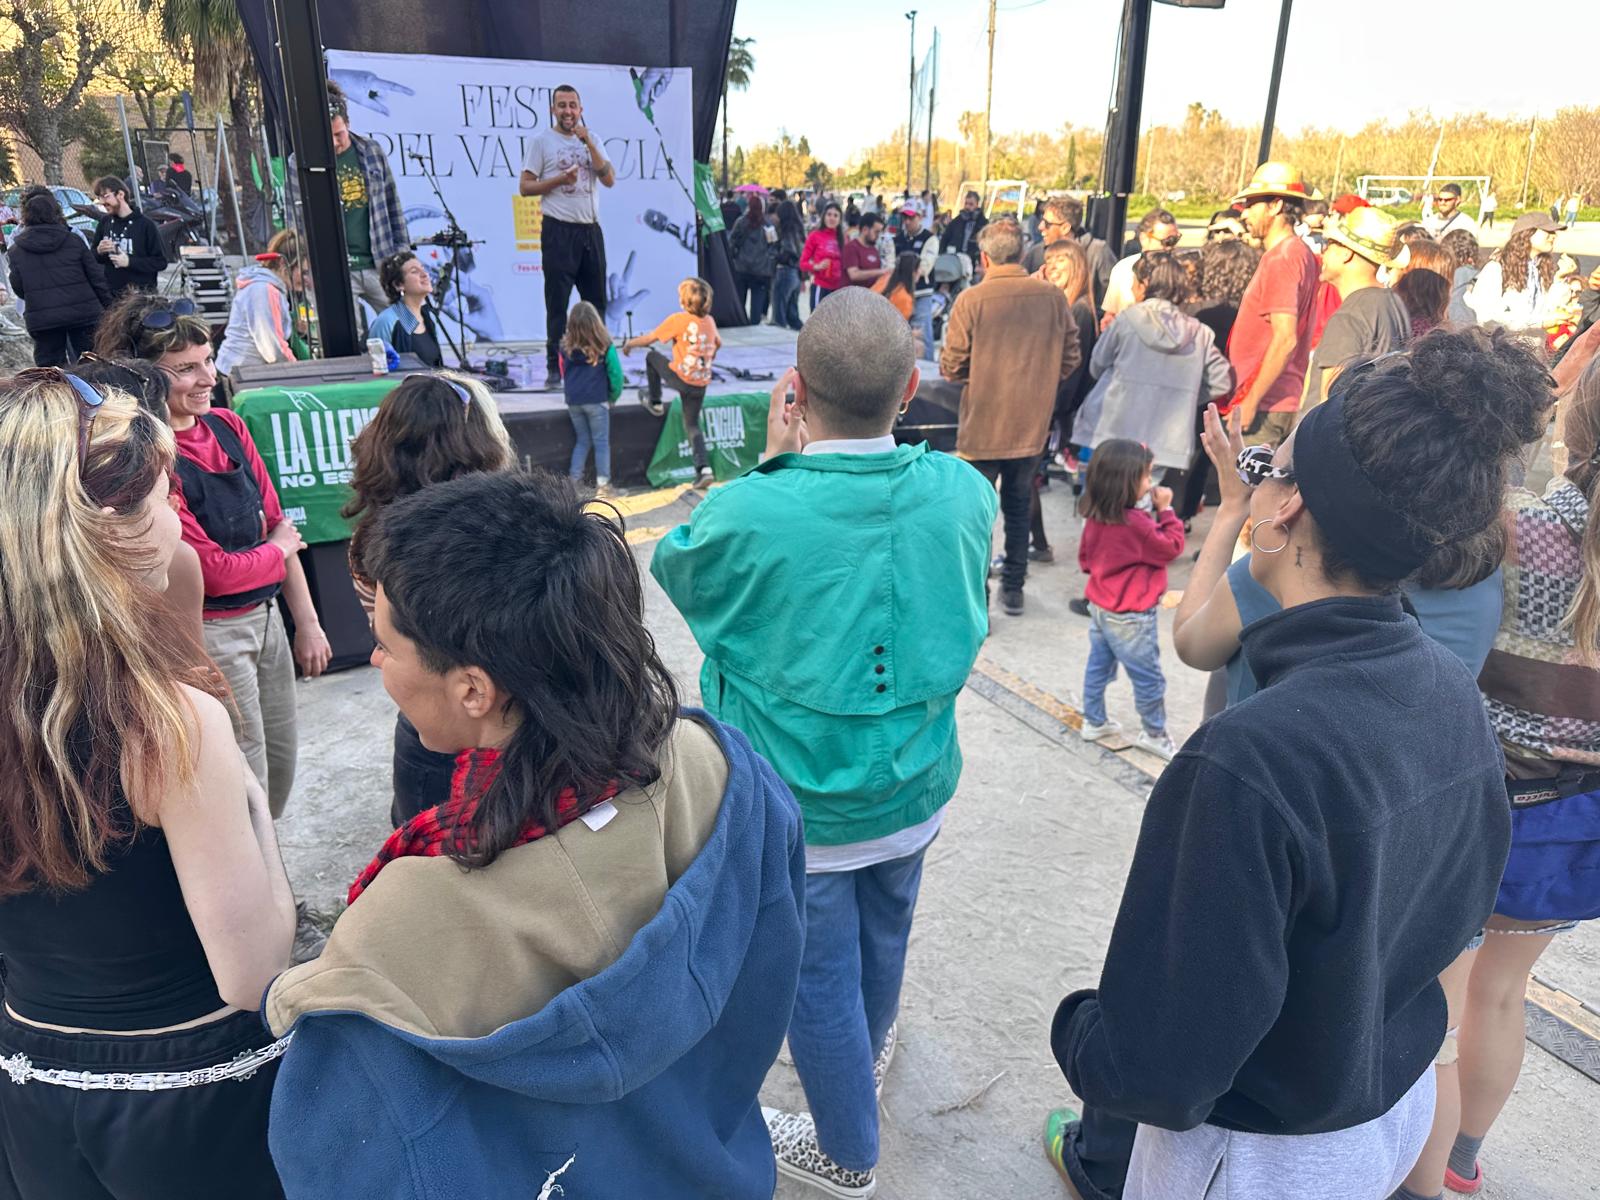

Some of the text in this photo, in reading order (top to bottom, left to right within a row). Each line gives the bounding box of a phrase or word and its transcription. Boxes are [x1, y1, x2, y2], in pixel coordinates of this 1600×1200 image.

[457, 83, 588, 129] FEST
[270, 407, 380, 475] LA LLE
[699, 406, 745, 442] LENGUA
[716, 440, 745, 449] TOCA
[280, 473, 316, 489] NO
